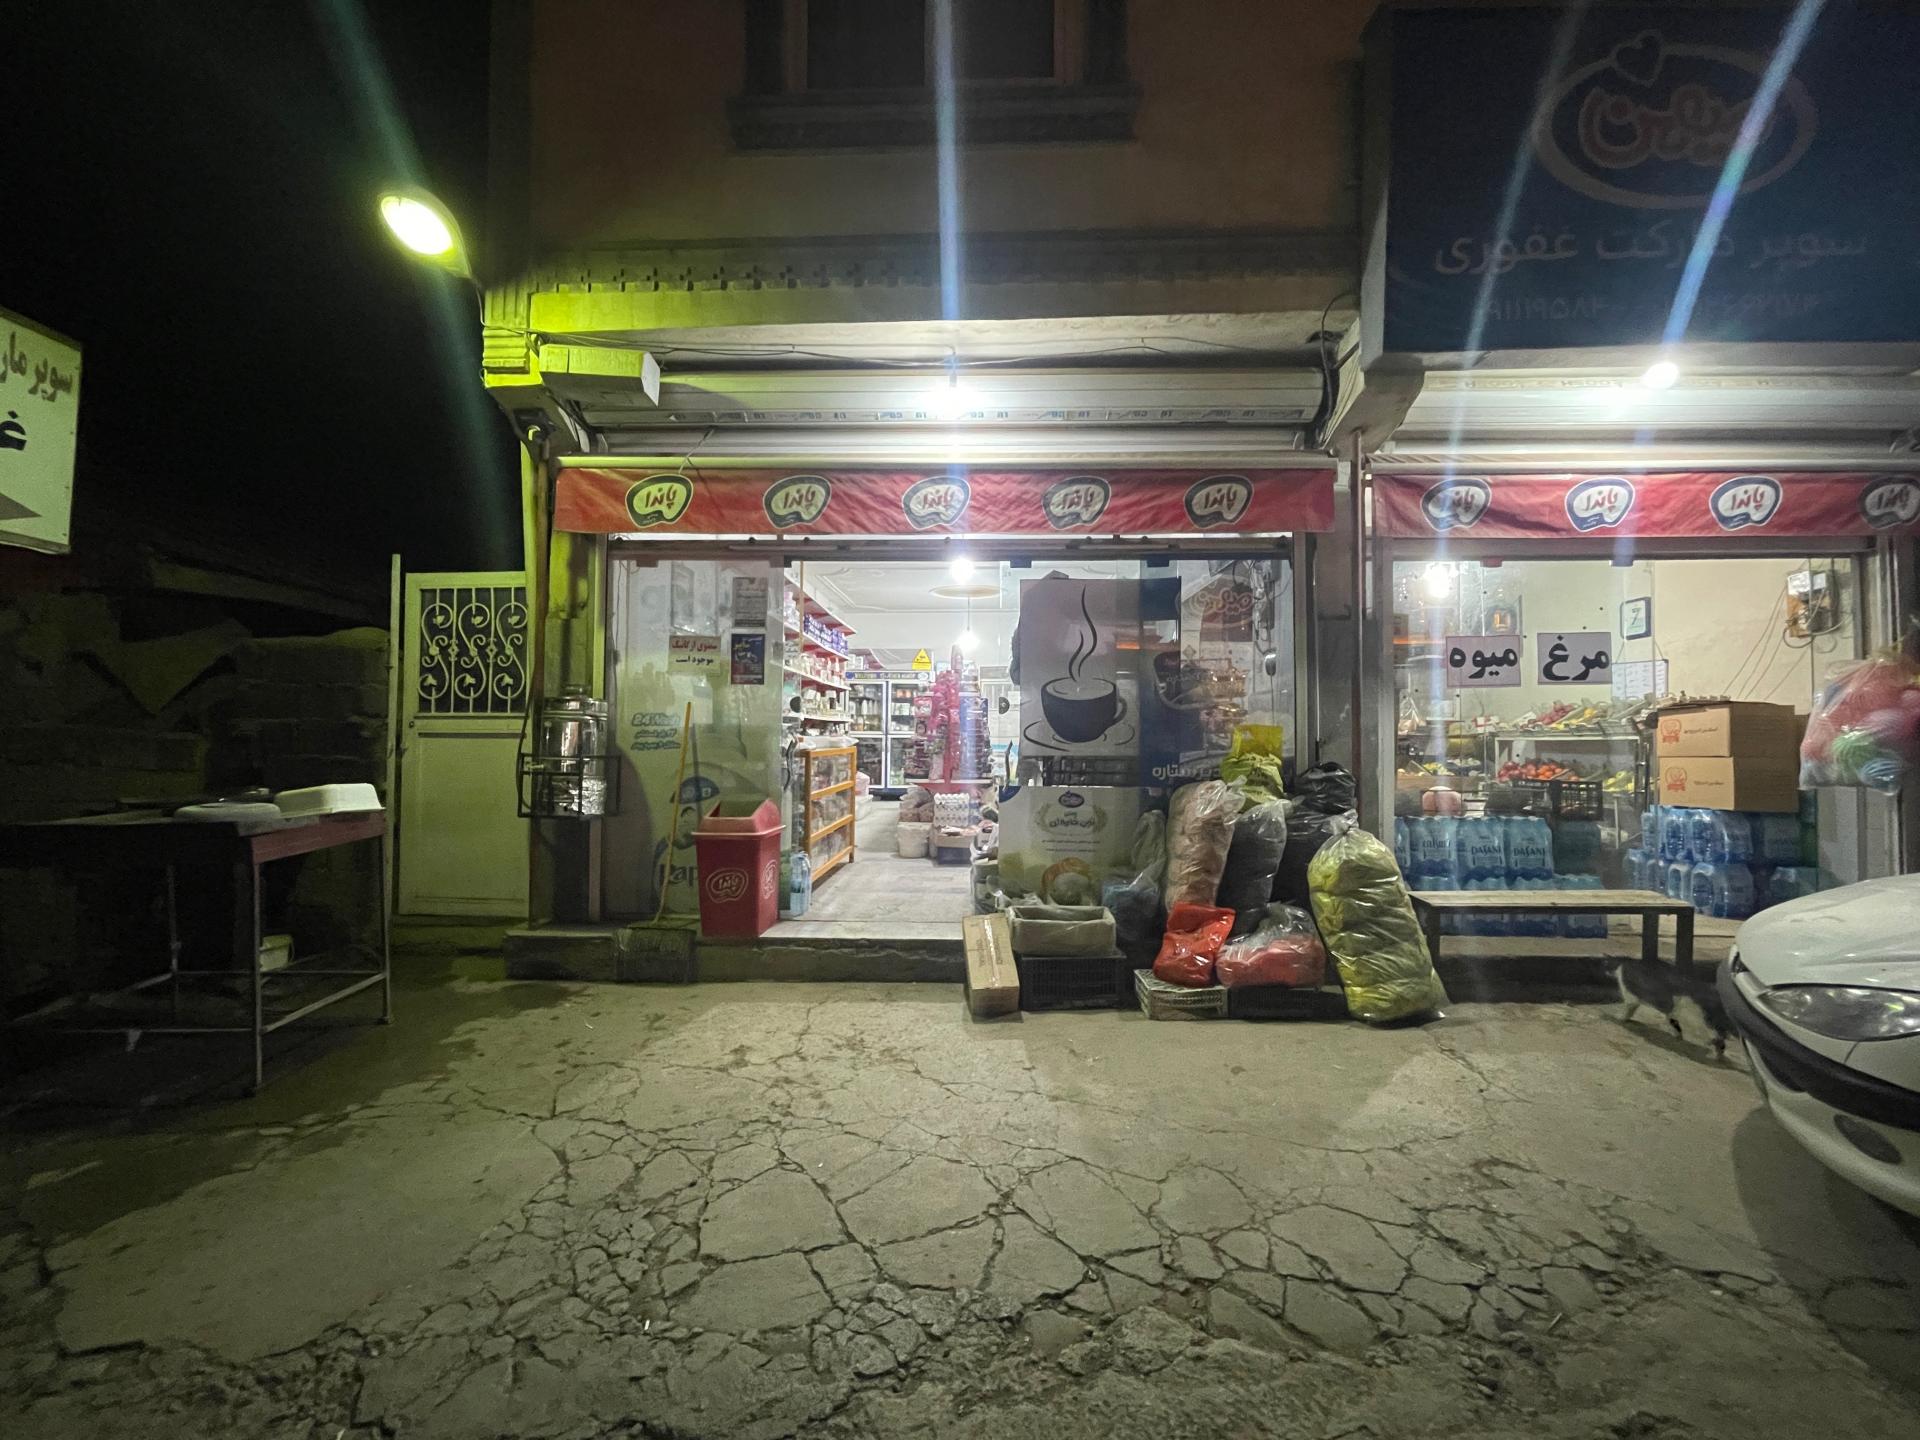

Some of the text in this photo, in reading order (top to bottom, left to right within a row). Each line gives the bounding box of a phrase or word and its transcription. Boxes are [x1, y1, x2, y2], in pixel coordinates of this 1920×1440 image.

[644, 485, 677, 509] پاندا
[782, 485, 815, 510] پاندا
[1203, 485, 1237, 510] پاندا
[1581, 488, 1618, 512] پاندا
[1731, 486, 1765, 510] پاندا
[1449, 646, 1518, 680] میوه
[1543, 634, 1610, 682] مرغ
